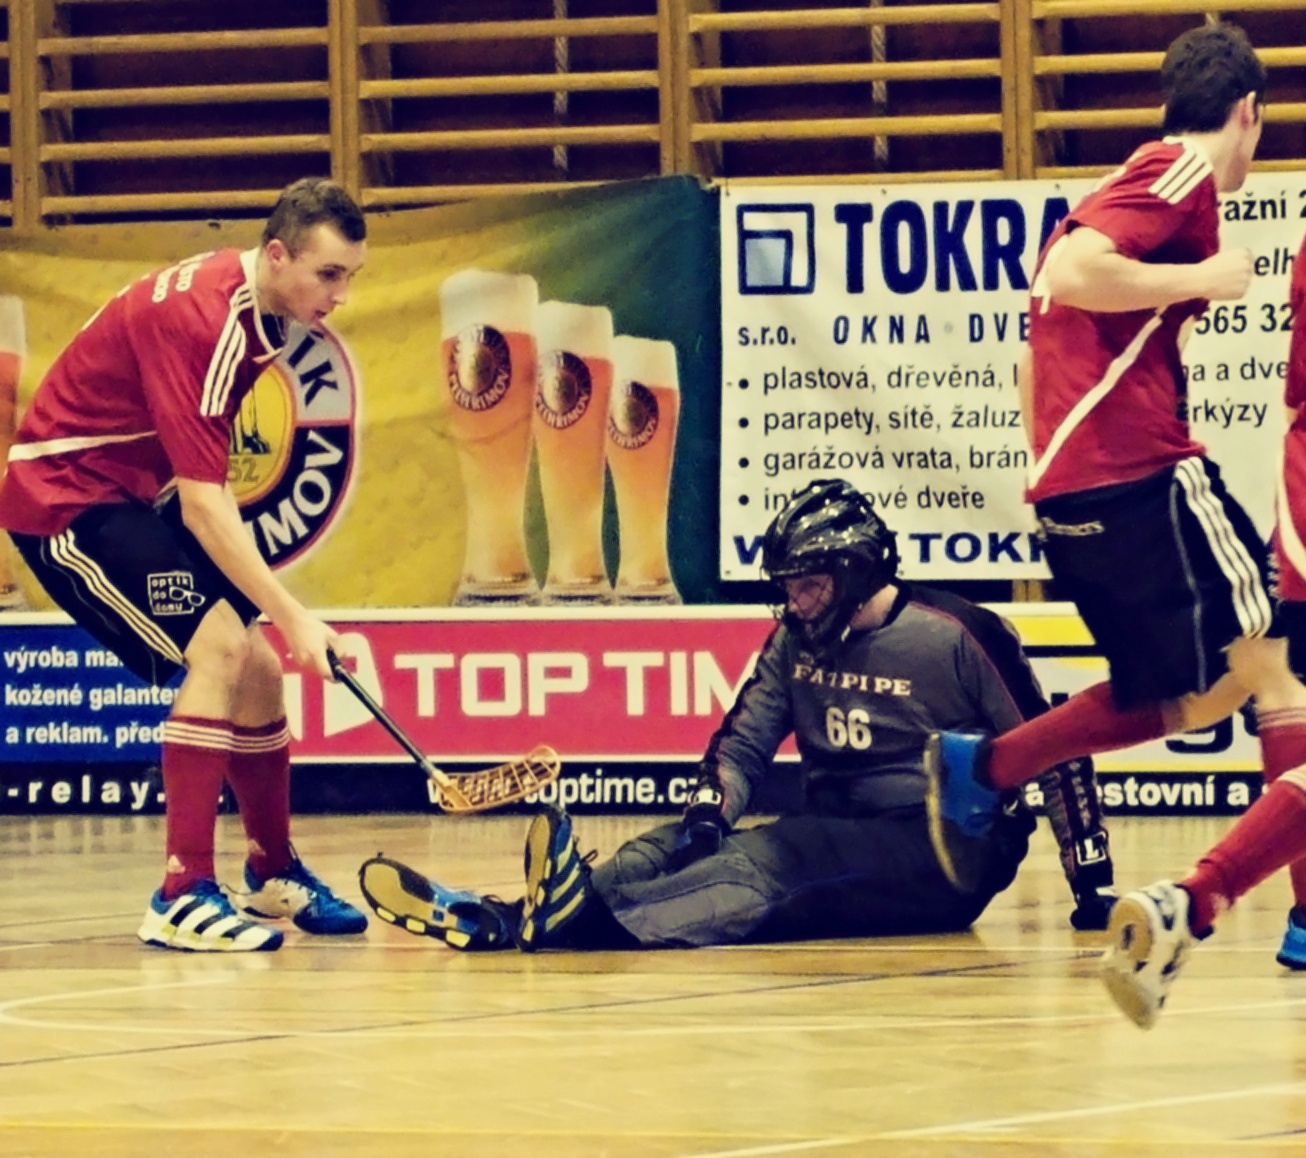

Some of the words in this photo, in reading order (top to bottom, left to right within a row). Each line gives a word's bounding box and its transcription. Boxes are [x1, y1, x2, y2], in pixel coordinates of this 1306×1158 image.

[1223, 191, 1288, 222] ažní
[1252, 247, 1296, 276] elh
[737, 324, 797, 347] s.r.o.
[833, 314, 931, 345] OKNA
[968, 311, 1030, 344] DVE
[1194, 305, 1248, 335] 565
[1260, 304, 1294, 333] 32
[763, 365, 877, 396] plastová,
[886, 363, 1004, 391] dřevěná,
[1215, 363, 1230, 382] a
[1239, 356, 1290, 381] dve
[763, 406, 881, 436] parapety,
[950, 403, 1022, 430] žaluz
[1192, 398, 1268, 429] rkýzy
[228, 458, 260, 483] 52
[763, 446, 885, 477] garážová
[892, 449, 961, 474] vrata,
[968, 449, 1029, 470] brán
[916, 485, 986, 510] dveře
[4, 646, 79, 673] výroba
[85, 650, 124, 668] ma
[5, 684, 83, 706] kožené
[393, 652, 590, 717] TOP
[602, 651, 760, 717] TIM
[5, 726, 19, 744] a
[26, 722, 109, 744] reklam.
[115, 722, 166, 748] před
[826, 706, 872, 751] 66
[7, 774, 168, 811] -relay.
[1227, 782, 1249, 806] a
